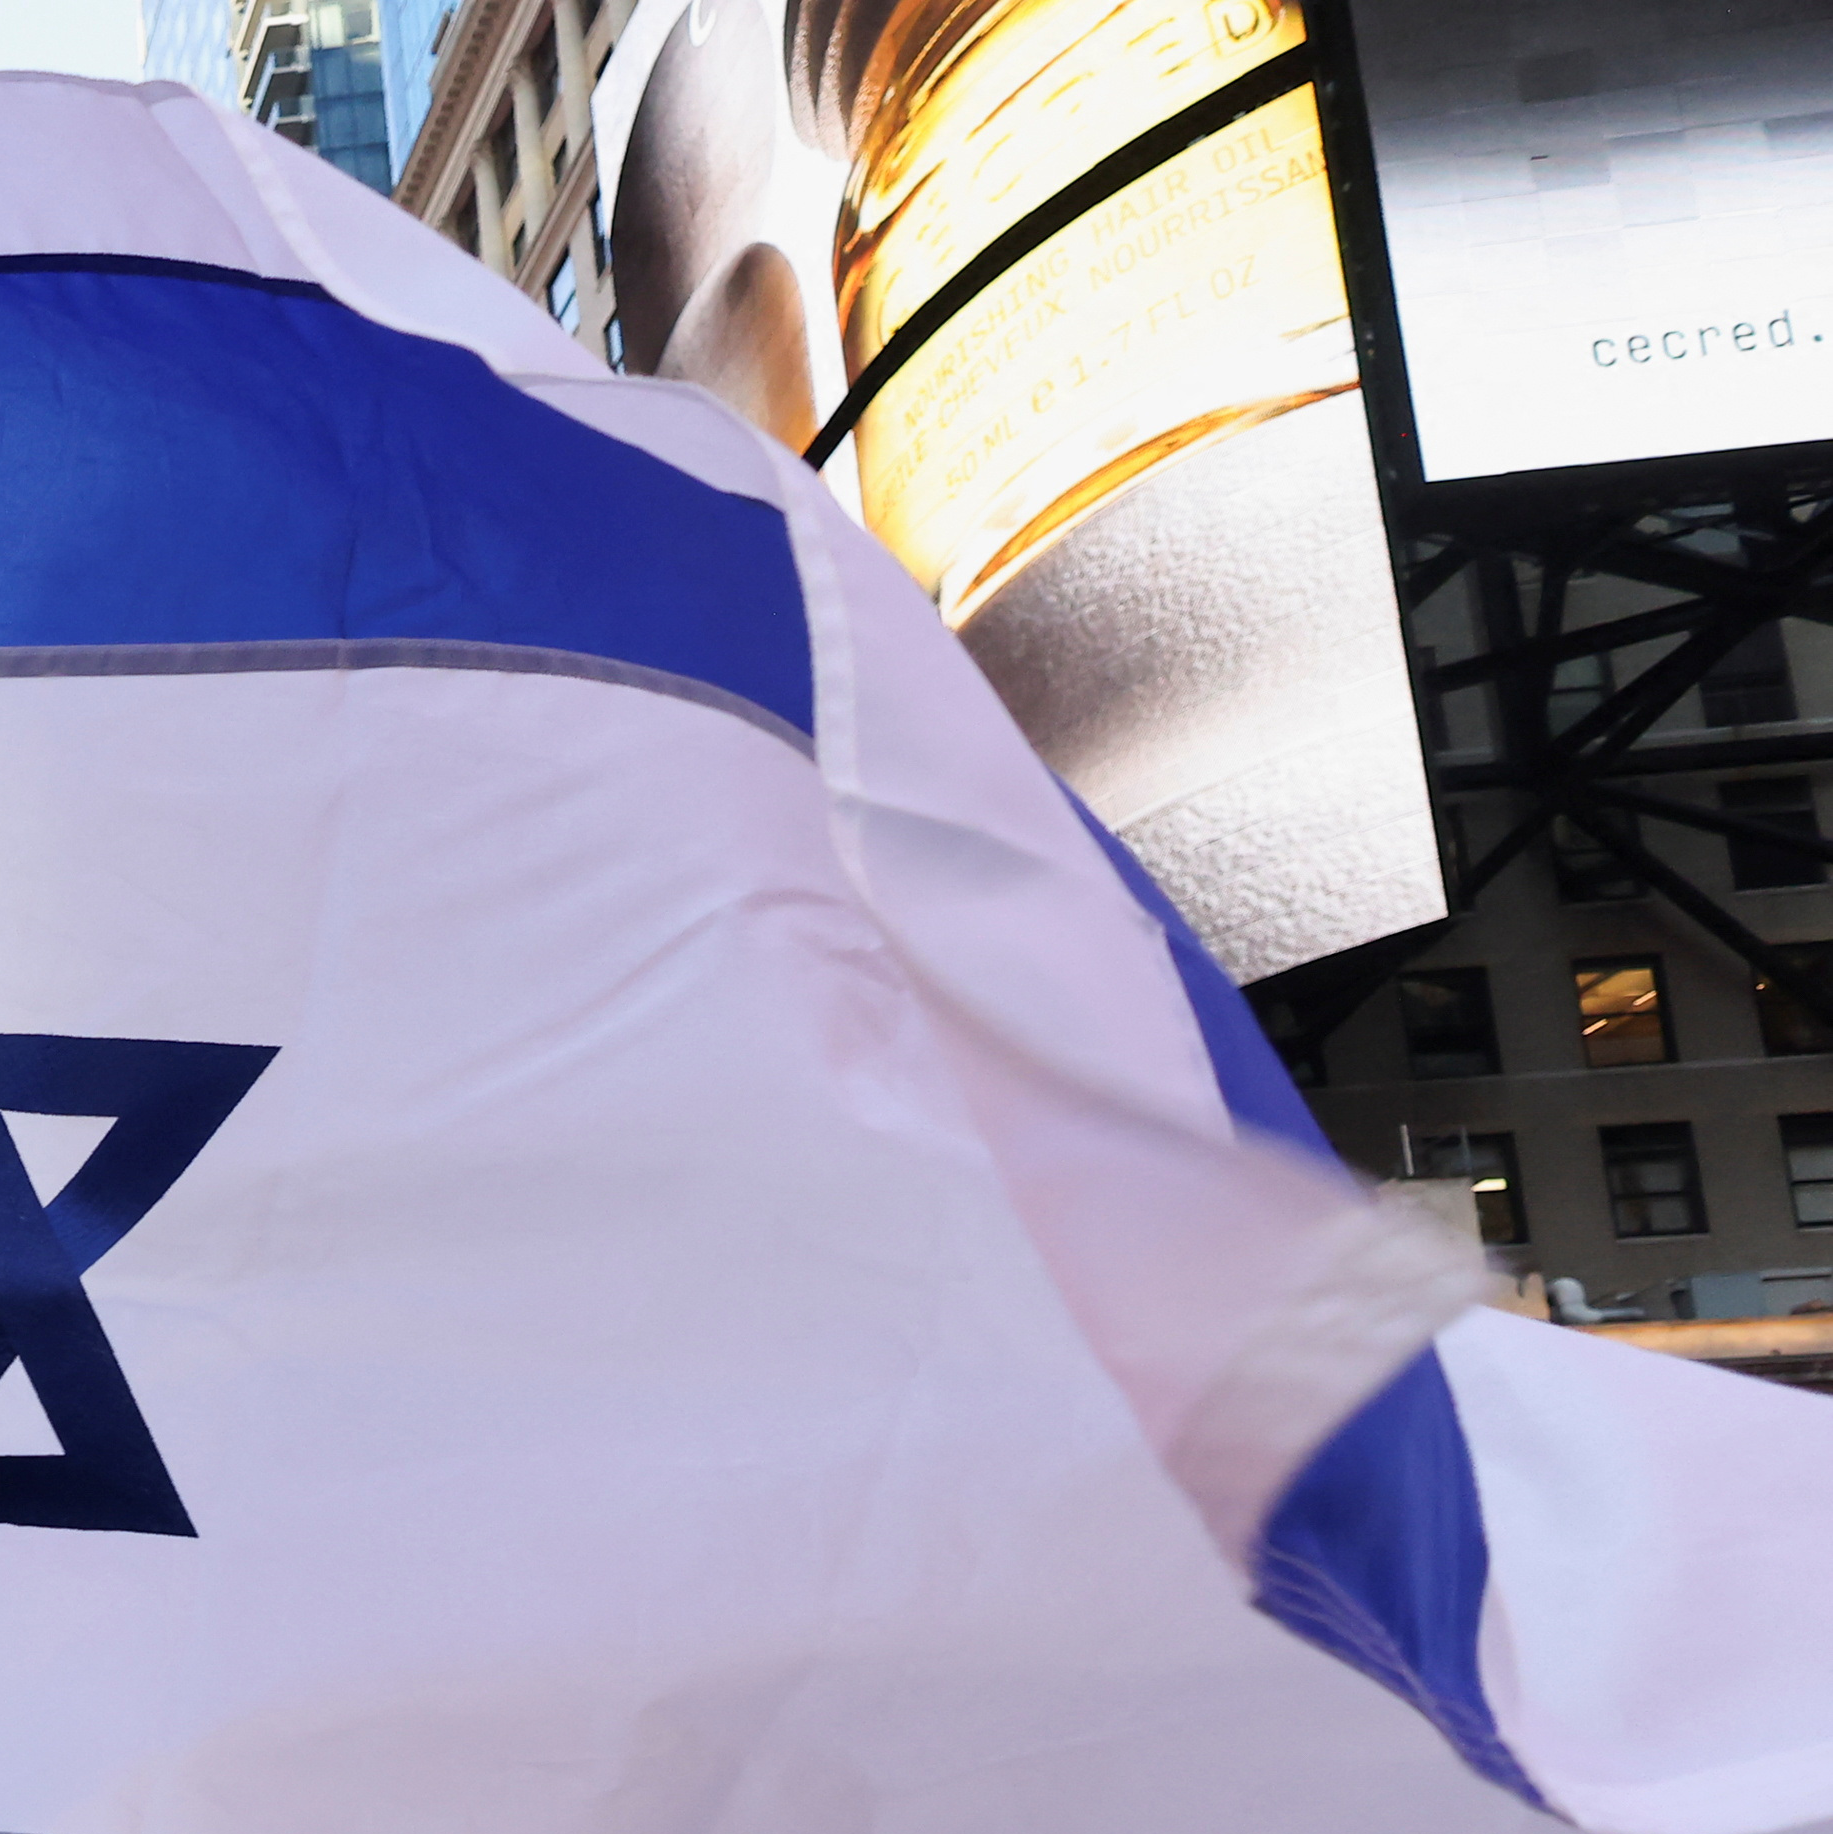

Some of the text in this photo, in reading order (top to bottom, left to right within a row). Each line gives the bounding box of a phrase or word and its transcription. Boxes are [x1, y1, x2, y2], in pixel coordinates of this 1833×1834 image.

[1092, 168, 1193, 247] HAIR
[1213, 127, 1283, 175] OIL
[983, 415, 1021, 457] ML
[1146, 288, 1197, 336] FL
[1210, 254, 1260, 300] OZ
